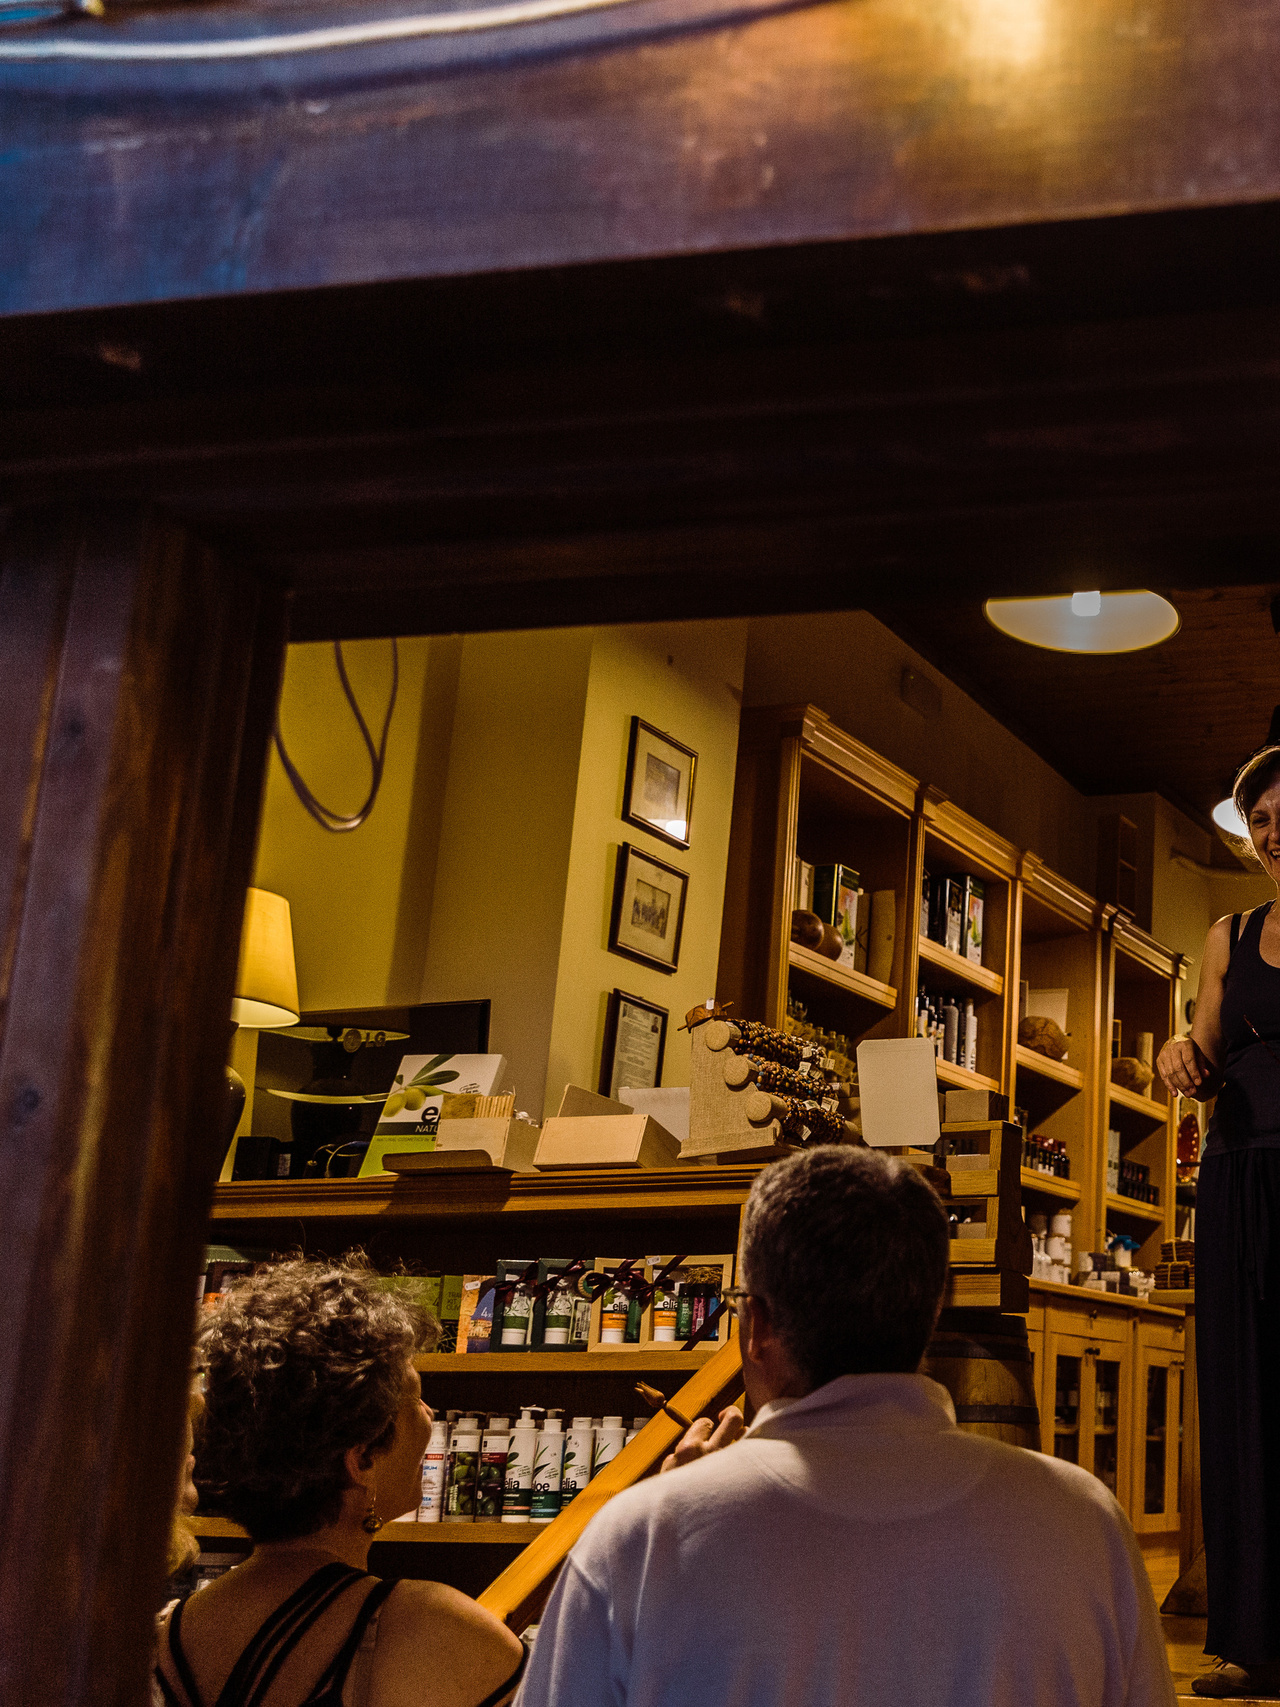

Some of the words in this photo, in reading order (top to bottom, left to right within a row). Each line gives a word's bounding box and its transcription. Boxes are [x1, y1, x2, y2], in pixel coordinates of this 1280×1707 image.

[365, 1031, 386, 1048] LG
[612, 1301, 628, 1312] elia
[662, 1299, 678, 1309] elia
